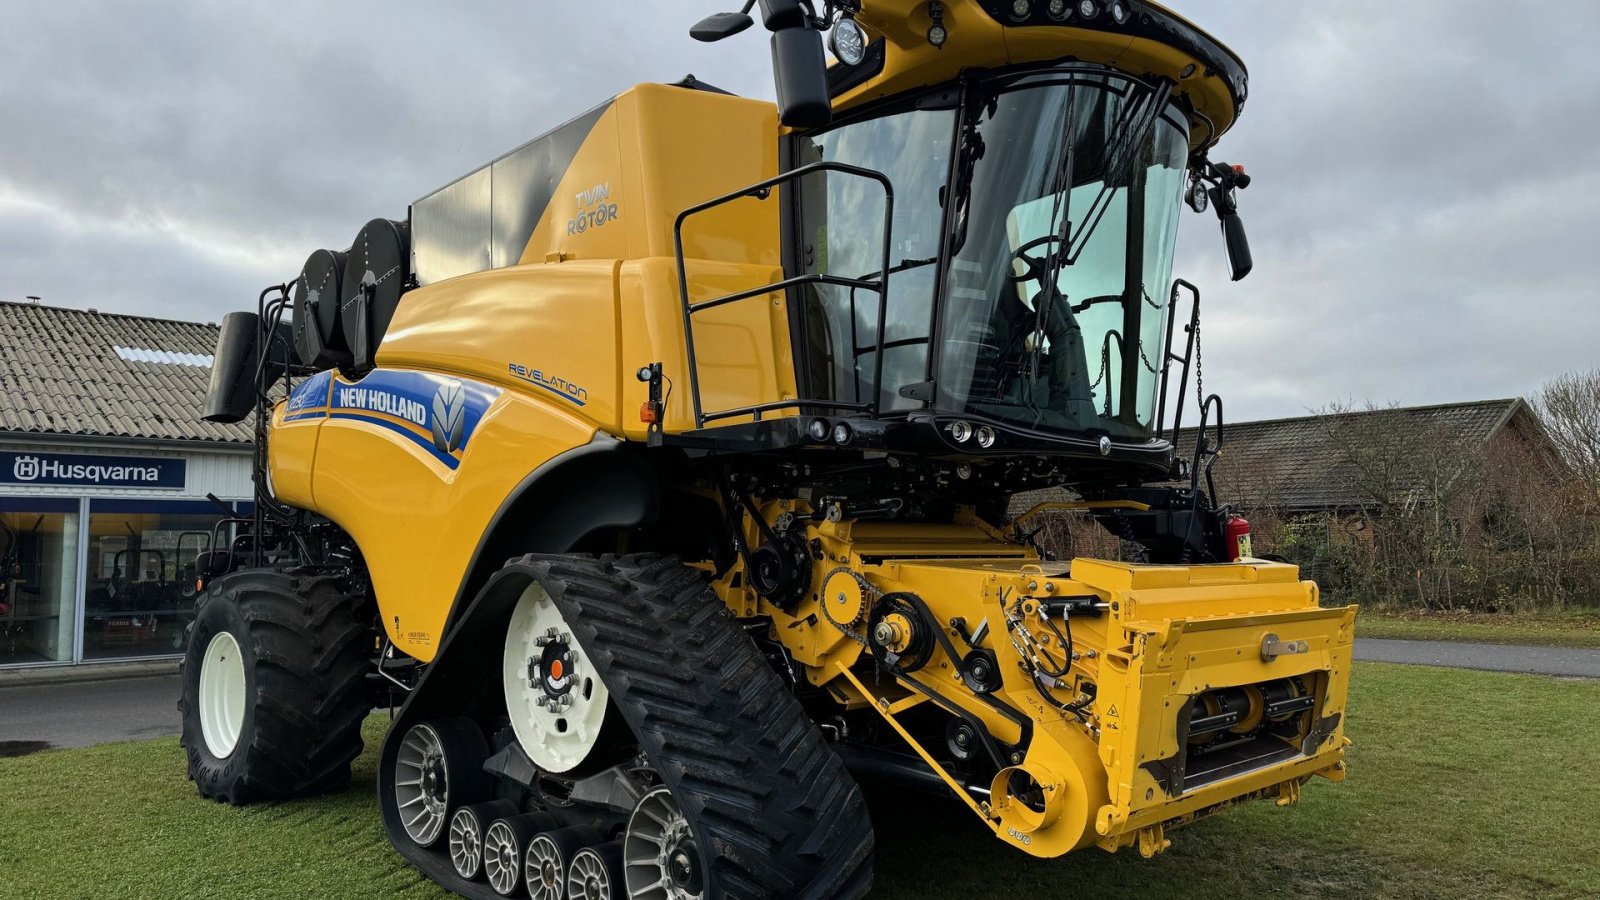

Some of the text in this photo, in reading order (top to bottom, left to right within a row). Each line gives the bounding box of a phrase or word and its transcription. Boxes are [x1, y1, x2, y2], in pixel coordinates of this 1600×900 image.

[576, 182, 608, 207] TWIN
[508, 363, 587, 400] REVELATION
[340, 388, 426, 426] NEW HOLLAND
[41, 460, 159, 482] Husqvarna
